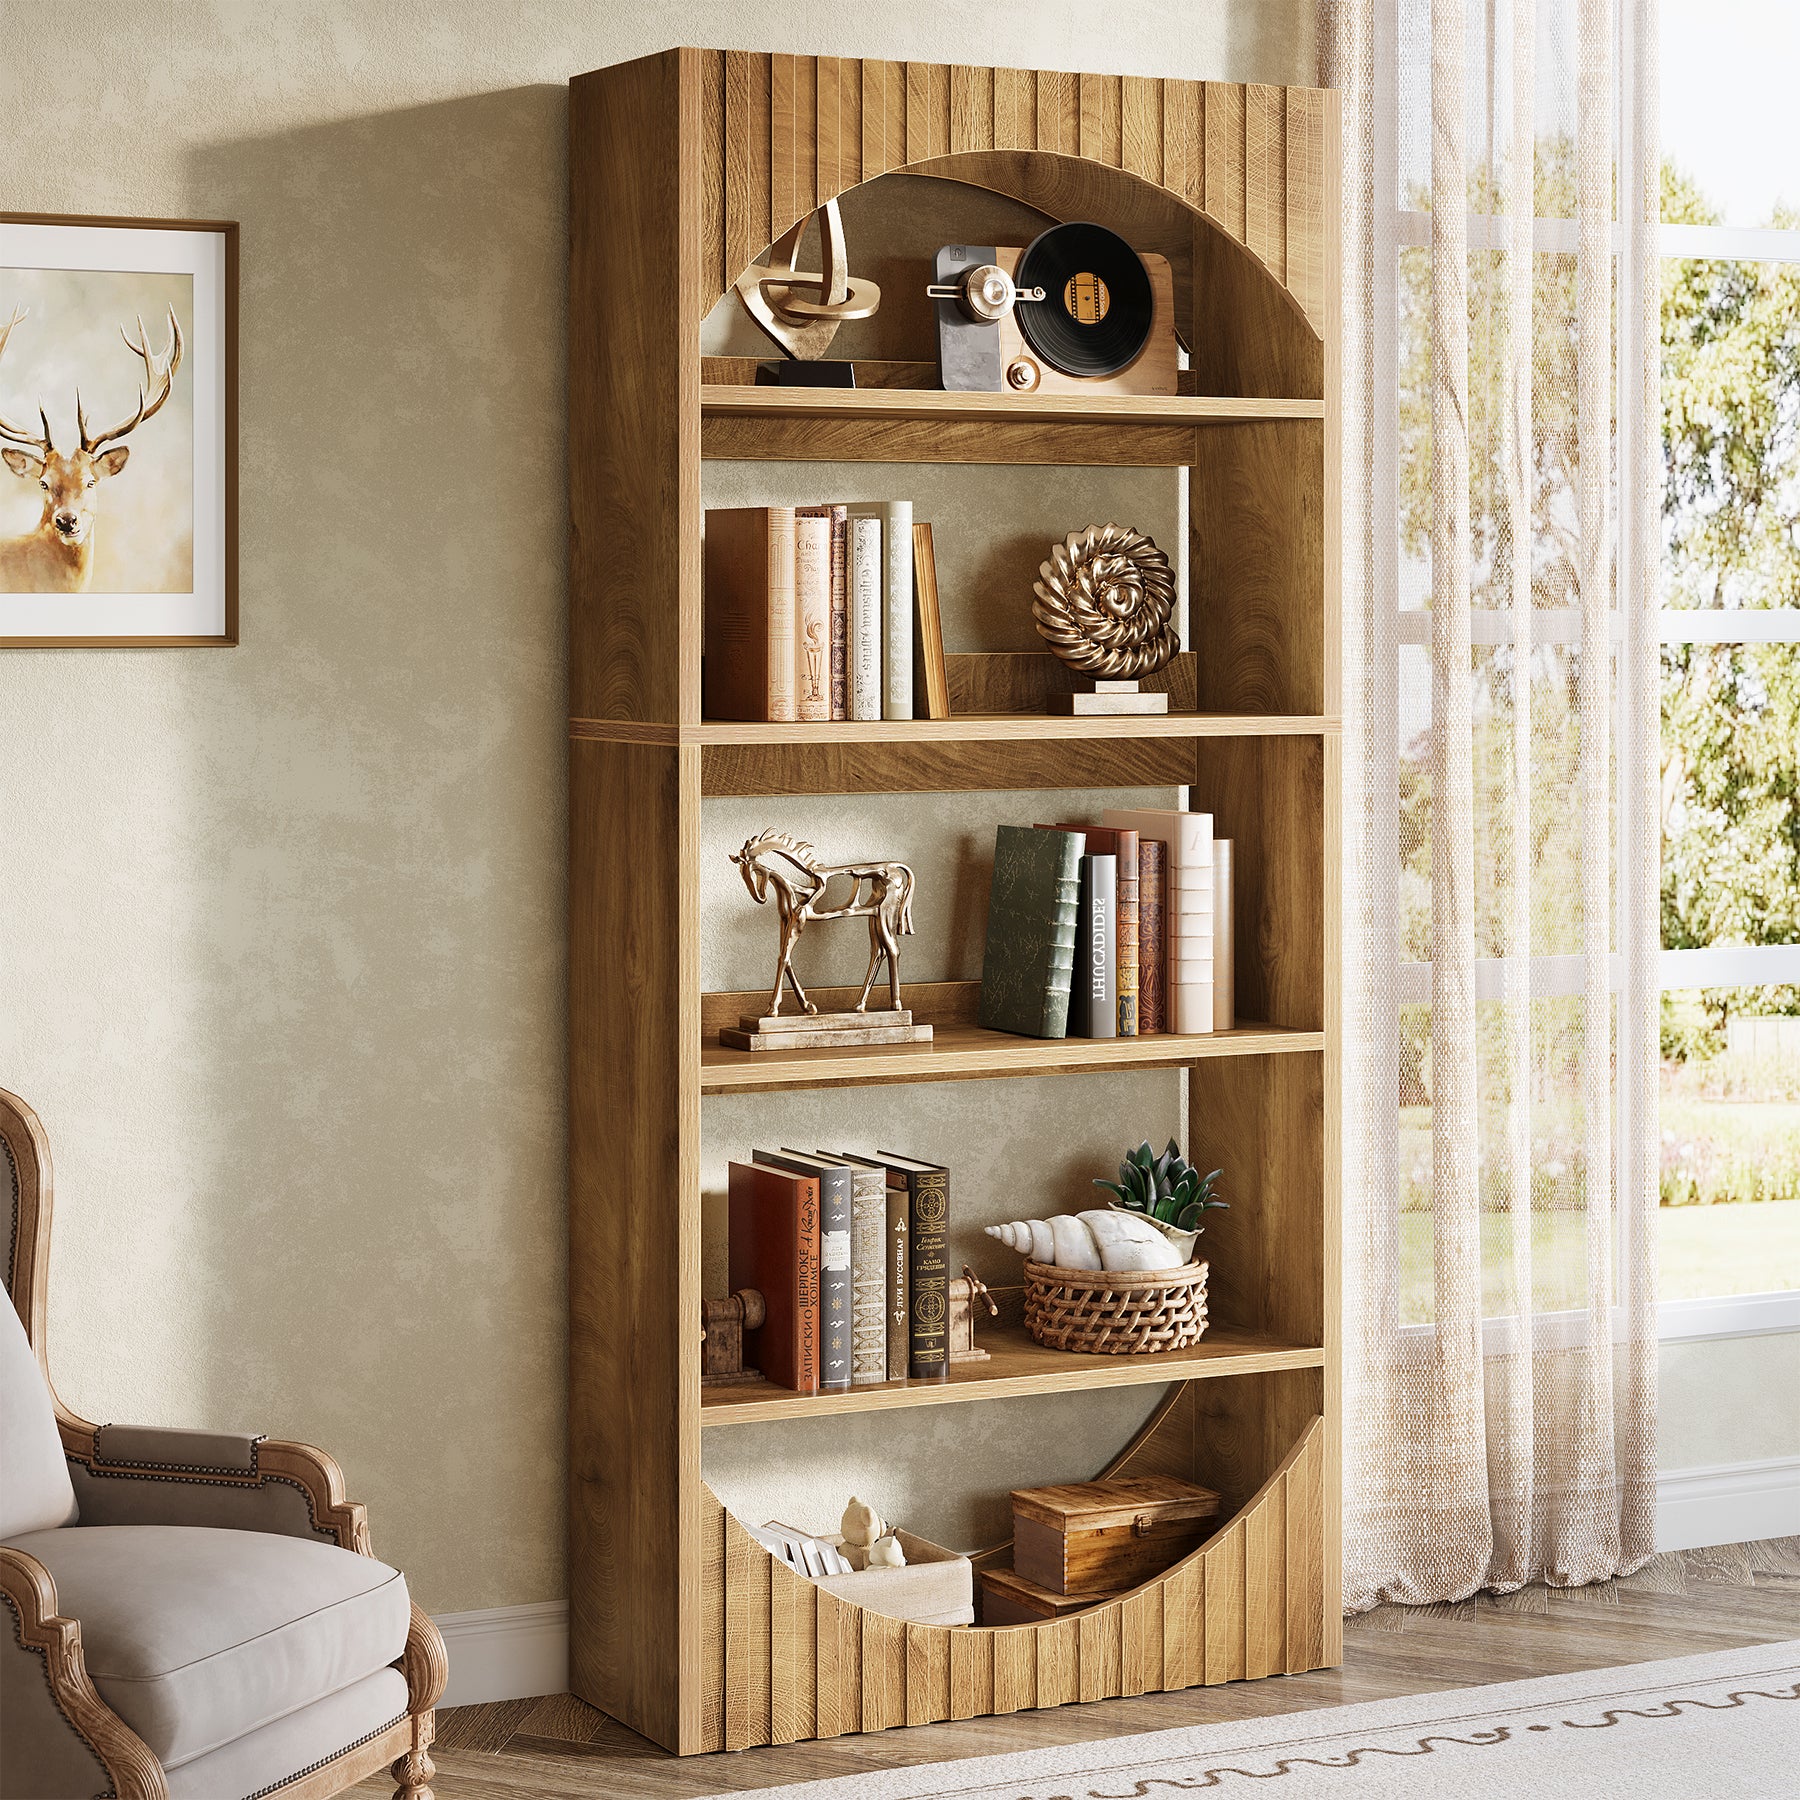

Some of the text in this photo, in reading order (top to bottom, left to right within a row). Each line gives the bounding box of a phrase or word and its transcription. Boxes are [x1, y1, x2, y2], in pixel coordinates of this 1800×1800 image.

[799, 1248, 809, 1307] ШЕРЛОКЕ
[809, 1254, 818, 1307] ХОЛМСЕ
[896, 1287, 904, 1308] ЛУИ
[803, 1321, 813, 1382] ЗАПИСКИ
